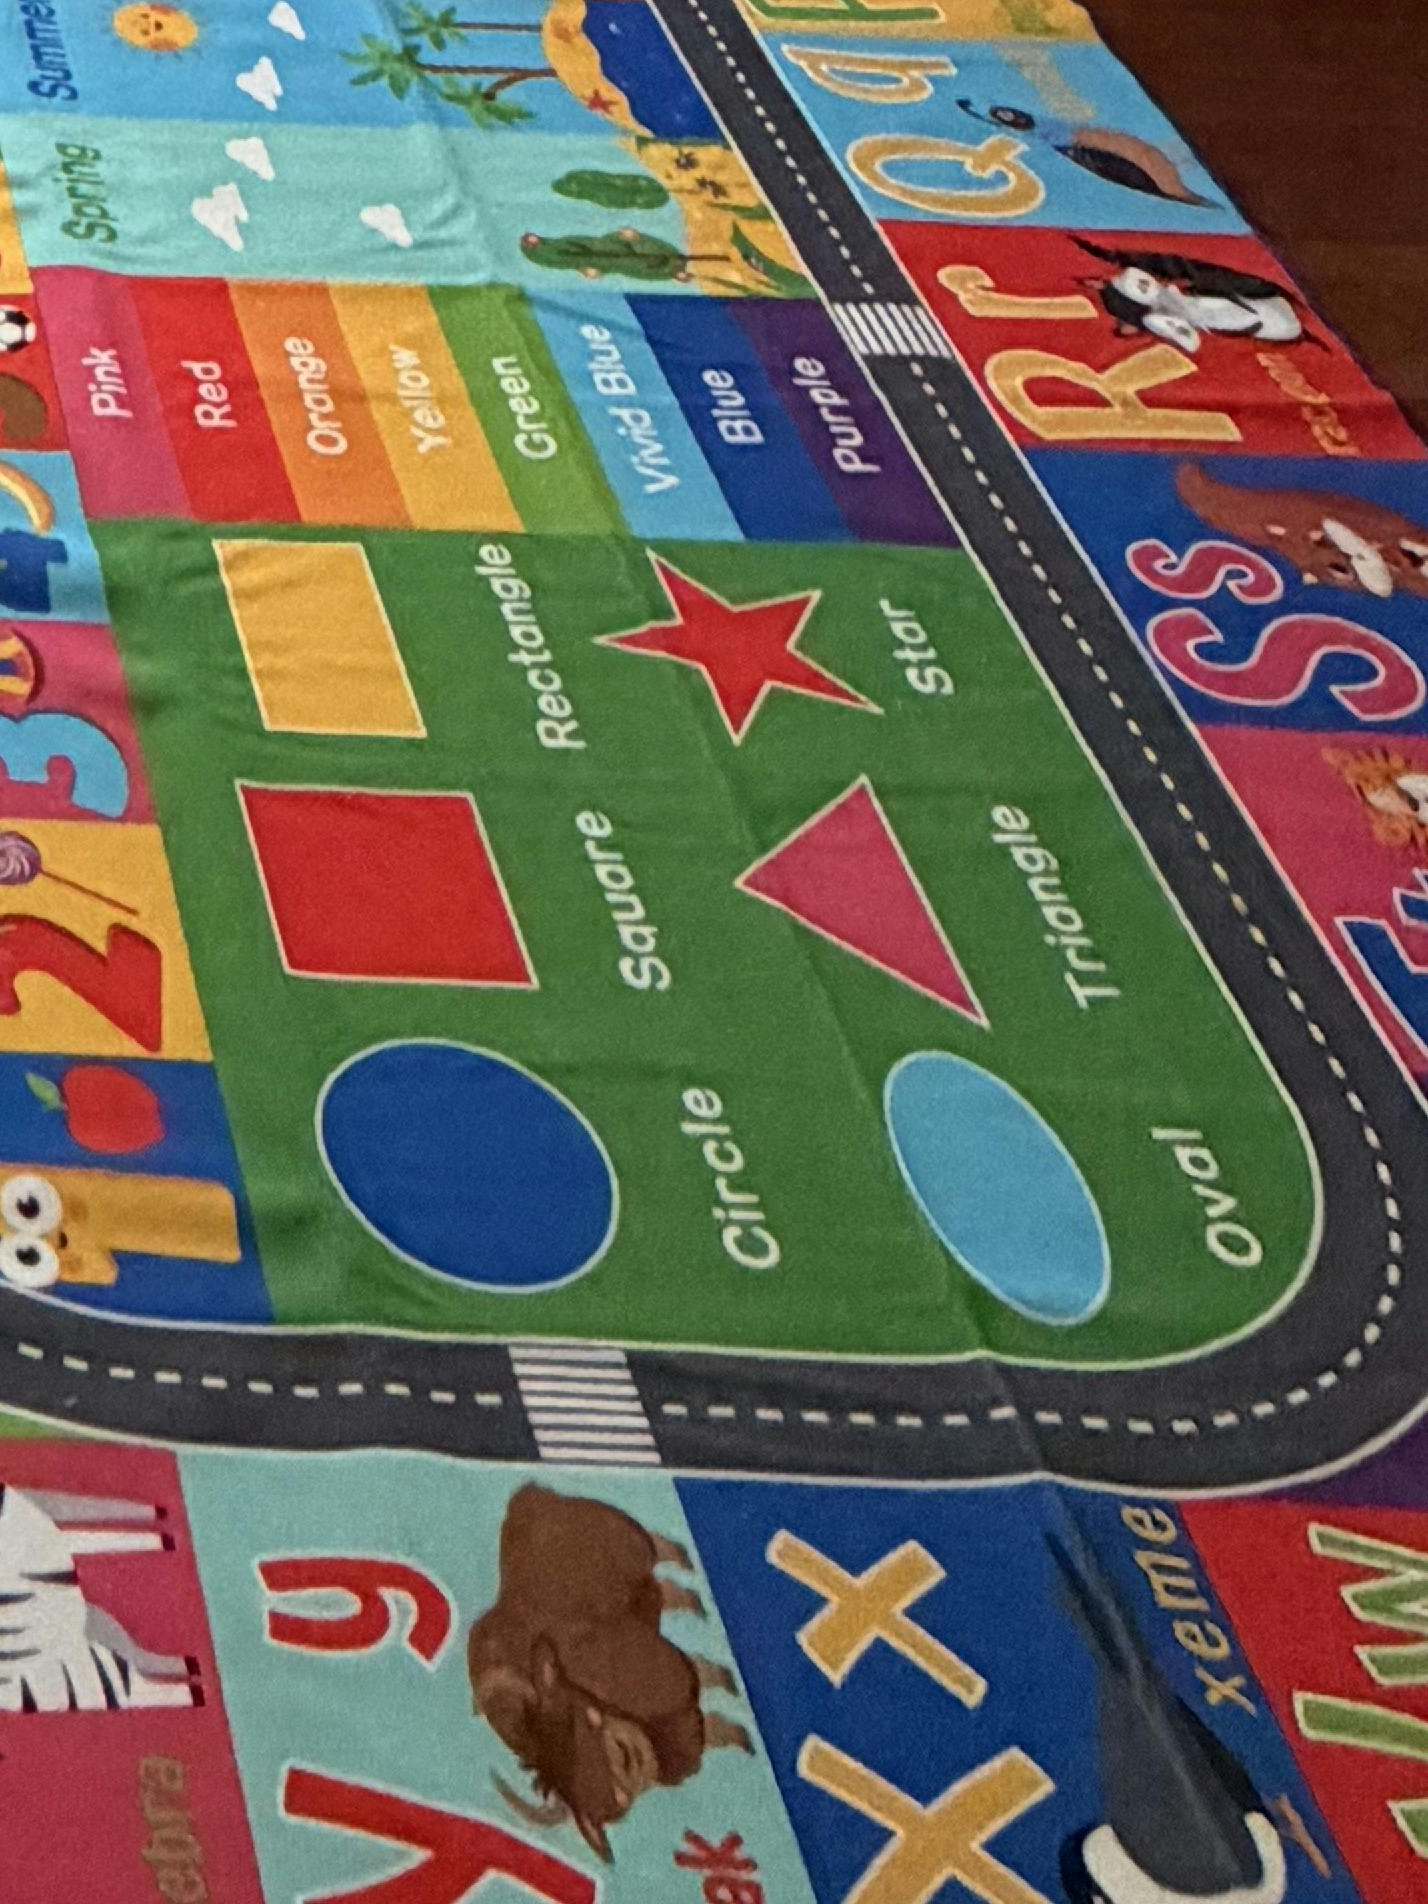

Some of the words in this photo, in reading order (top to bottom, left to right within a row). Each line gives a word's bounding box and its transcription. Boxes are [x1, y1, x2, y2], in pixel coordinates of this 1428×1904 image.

[778, 39, 1048, 220] Qq
[61, 141, 121, 247] Spring
[89, 345, 134, 421] Pink
[181, 359, 239, 430] Red
[283, 335, 350, 457] Orange
[387, 343, 453, 457] Yellow
[488, 353, 560, 463] Green
[580, 320, 641, 402] Blue
[700, 366, 768, 447] Blue
[935, 263, 1245, 446] Rr
[628, 402, 682, 497] Vivid
[791, 355, 882, 476] Purple
[473, 541, 590, 753] Rectangle
[878, 596, 957, 699] Star
[1124, 535, 1428, 722] Ss
[574, 808, 674, 993] Square
[990, 803, 1123, 1011] Triangle
[681, 1083, 784, 1271] Circle
[1149, 1123, 1265, 1268] Oval
[1120, 1504, 1258, 1718] xeme
[764, 1526, 1057, 1904] Xx
[672, 1824, 765, 1904] ak
